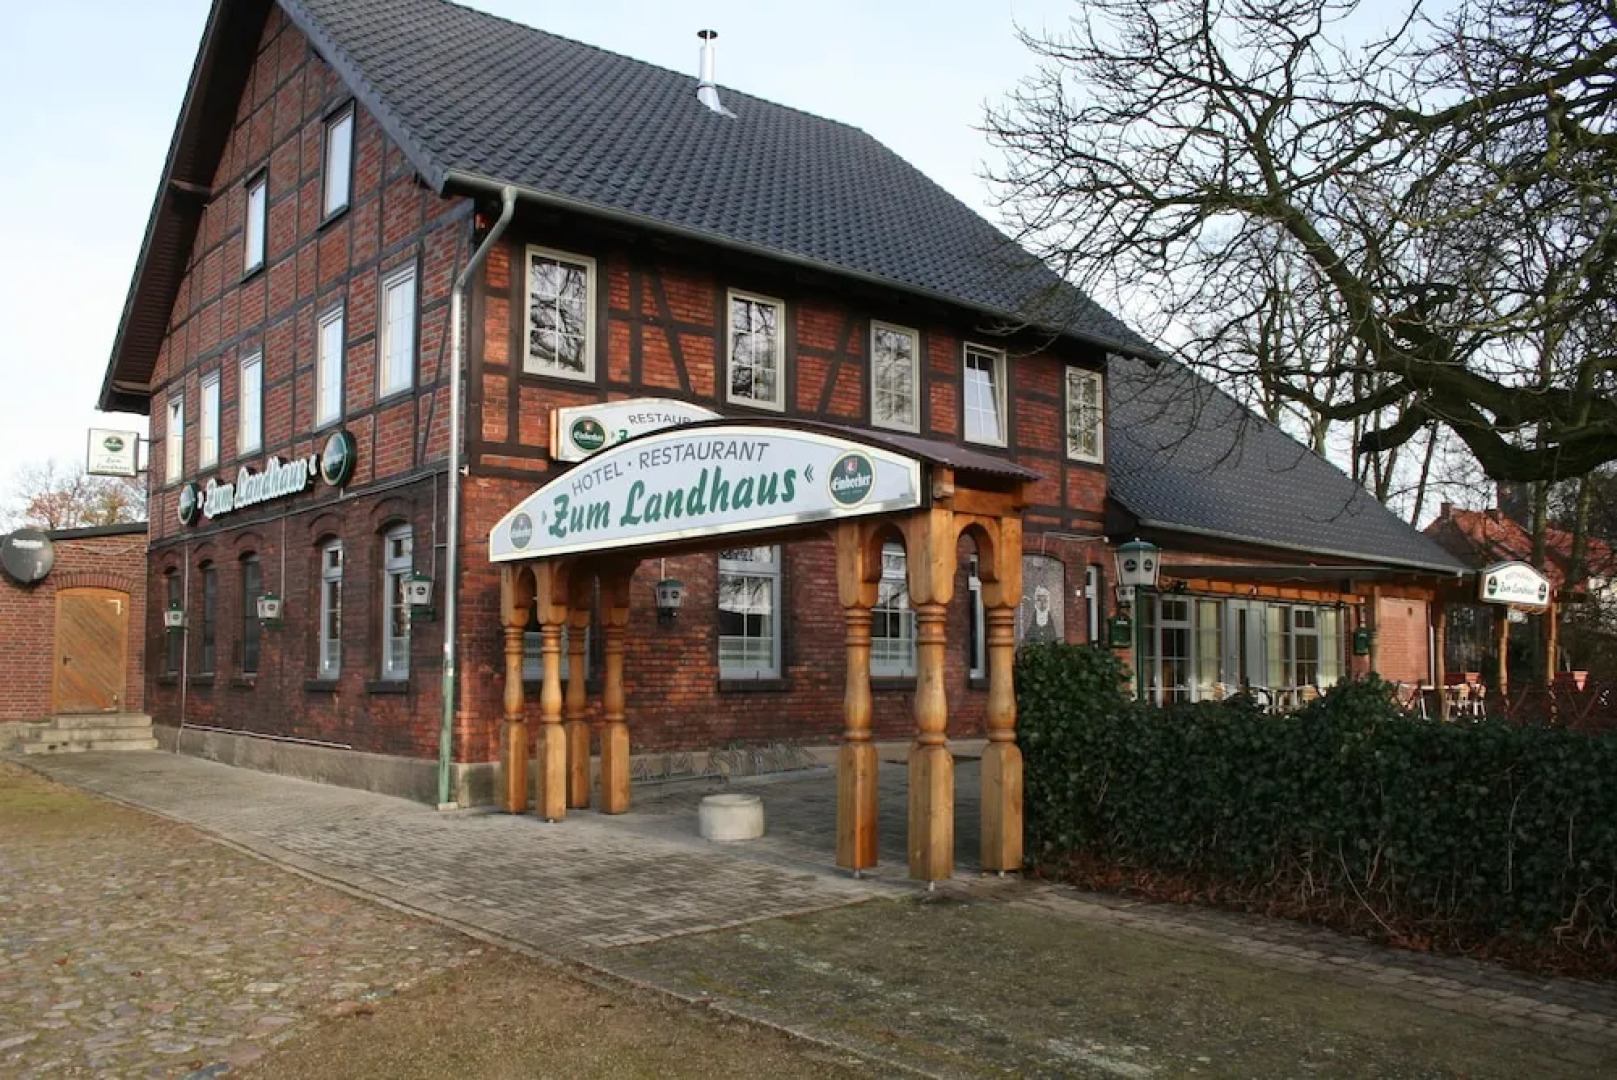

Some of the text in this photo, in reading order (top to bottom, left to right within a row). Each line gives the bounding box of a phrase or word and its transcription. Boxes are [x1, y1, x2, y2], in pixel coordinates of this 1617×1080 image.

[203, 455, 308, 520] Zum Landhaus
[571, 440, 771, 497] HOTEL RESTAURANT
[548, 465, 797, 538] Zum Landhaus
